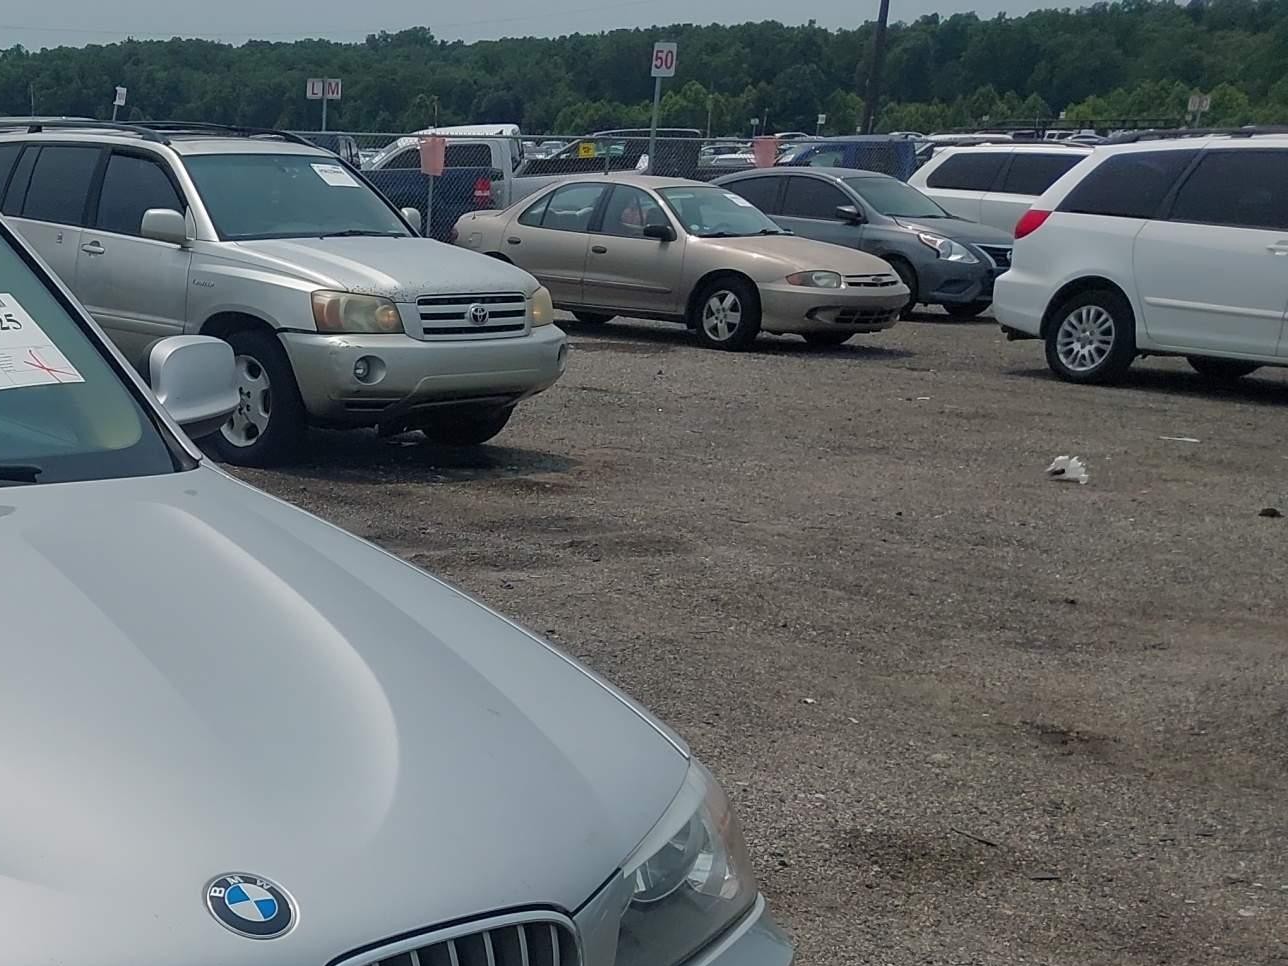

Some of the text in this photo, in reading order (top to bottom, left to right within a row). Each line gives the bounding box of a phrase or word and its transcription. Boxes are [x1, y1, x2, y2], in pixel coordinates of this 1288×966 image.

[654, 49, 674, 70] 50
[311, 80, 340, 96] L M
[210, 875, 271, 897] BMW
